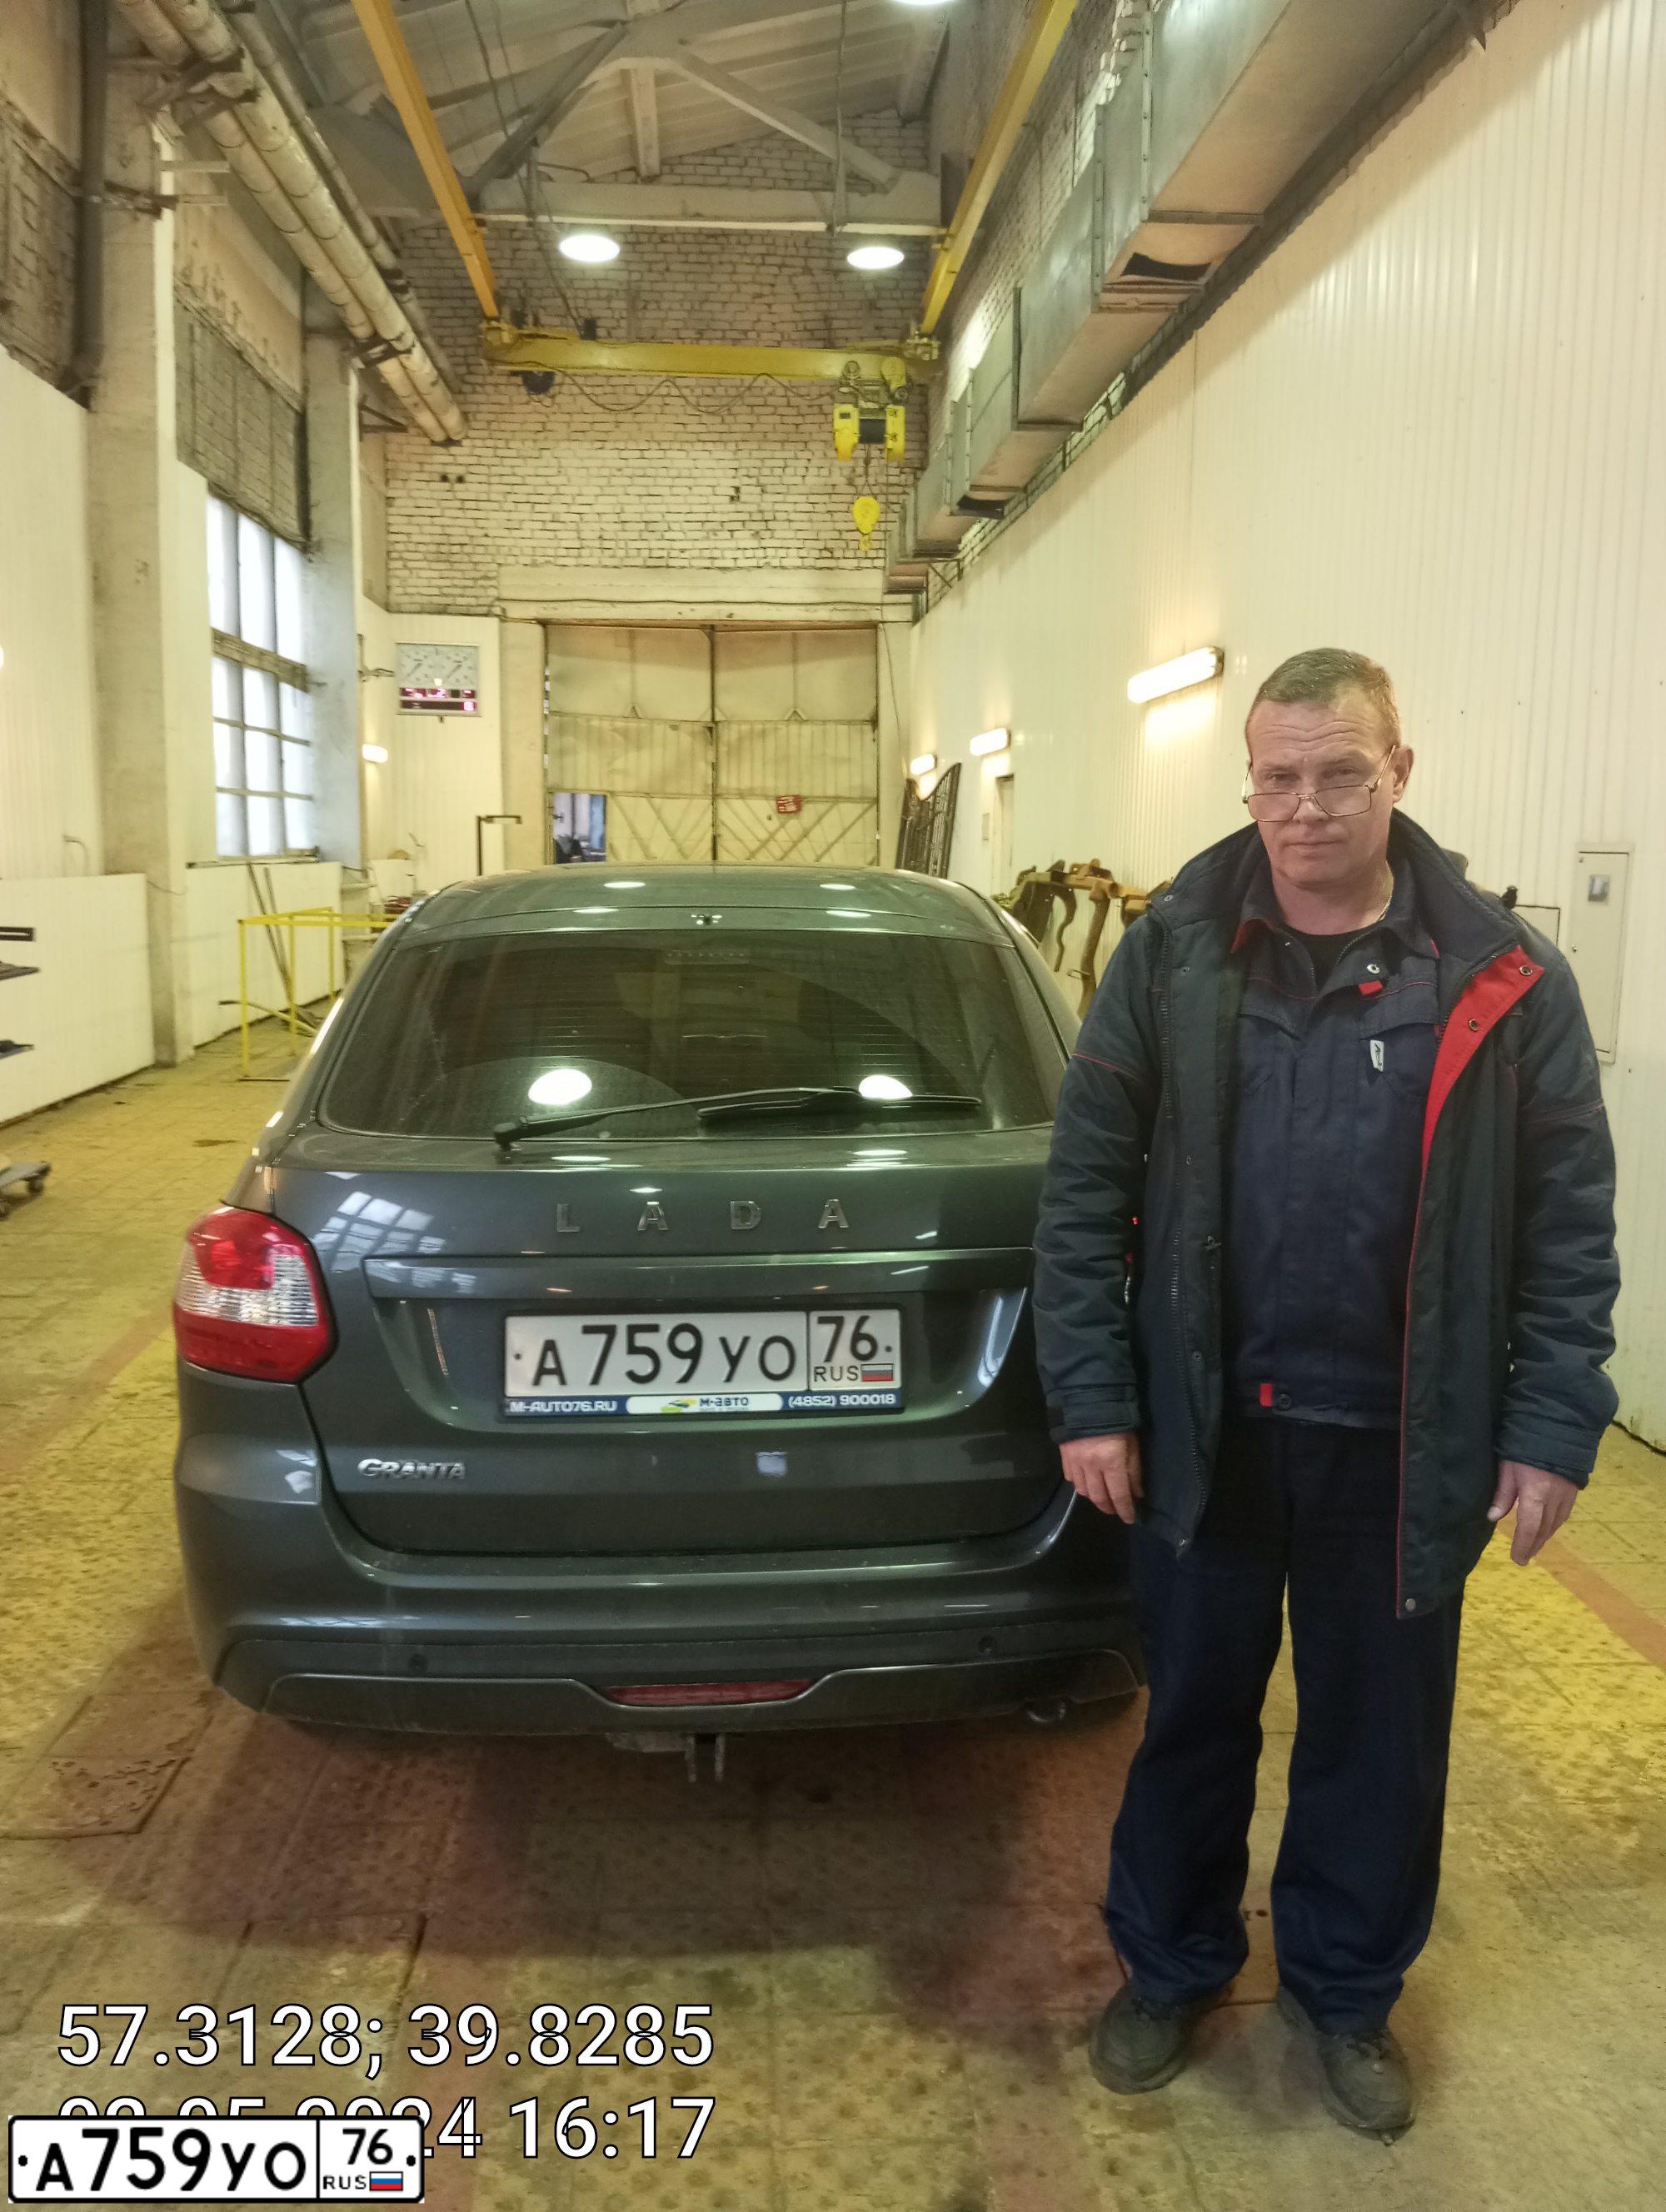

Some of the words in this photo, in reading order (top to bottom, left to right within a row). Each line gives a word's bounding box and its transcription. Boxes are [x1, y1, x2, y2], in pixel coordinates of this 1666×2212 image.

[556, 1198, 850, 1233] LADA
[817, 1315, 877, 1363] 76
[813, 1366, 858, 1382] RUS
[788, 1395, 837, 1409] (4852)
[839, 1393, 897, 1406] 900018
[357, 1458, 466, 1479] GRANTA
